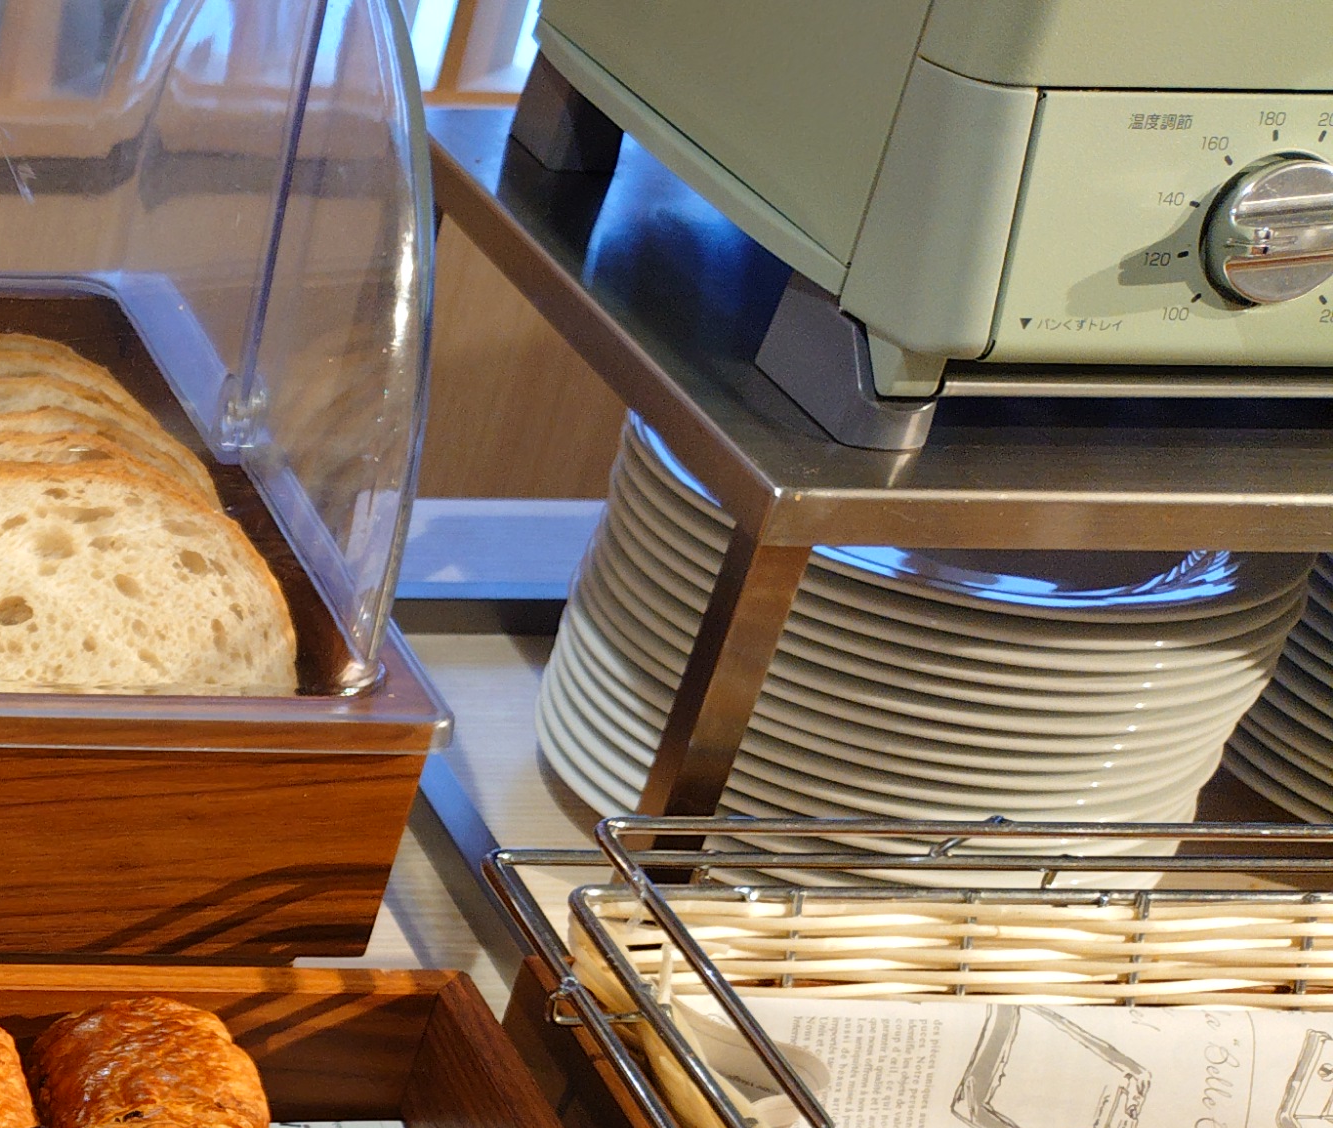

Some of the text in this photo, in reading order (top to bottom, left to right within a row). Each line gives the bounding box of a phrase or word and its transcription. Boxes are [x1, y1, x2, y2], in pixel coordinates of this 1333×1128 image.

[1127, 113, 1194, 131] 温度調節
[1257, 110, 1287, 127] 180
[1200, 135, 1230, 152] 160
[1156, 191, 1185, 207] 140
[1143, 251, 1172, 267] 120
[1161, 306, 1190, 322] 100
